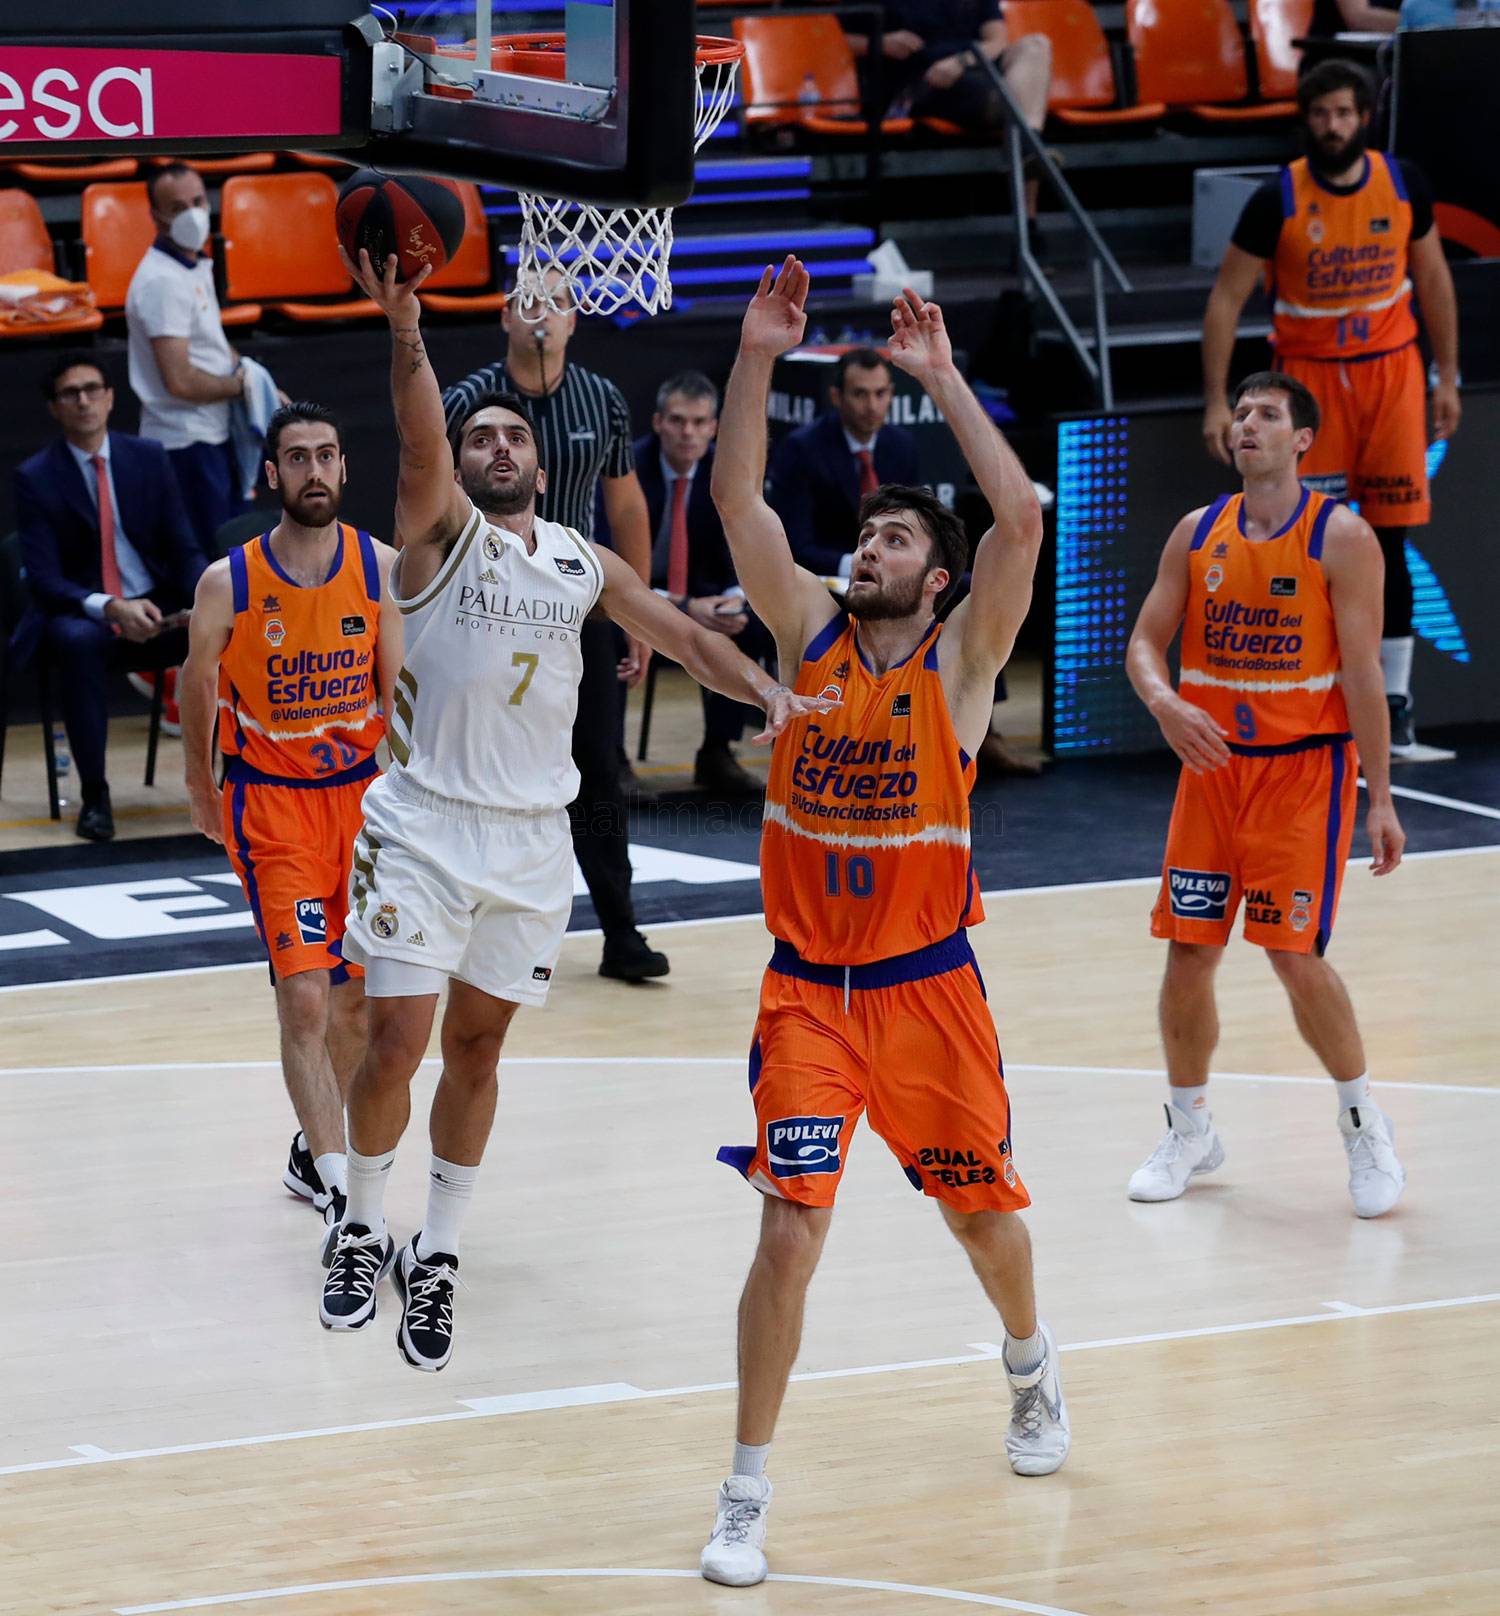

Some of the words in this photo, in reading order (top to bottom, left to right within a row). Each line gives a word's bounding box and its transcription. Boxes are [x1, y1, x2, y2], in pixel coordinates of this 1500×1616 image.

[1336, 317, 1370, 347] 14
[884, 394, 945, 425] ILA
[1204, 598, 1279, 627] Cultura
[1280, 614, 1303, 627] del
[456, 617, 516, 636] HOTEL
[534, 630, 579, 642] GRO
[1204, 624, 1303, 654] Esfuerzo
[267, 649, 354, 678] Cultura
[267, 672, 369, 705] Esfuerzo
[508, 652, 539, 706] 7
[1234, 702, 1257, 741] 9
[893, 743, 916, 762] del
[825, 851, 875, 899] 10
[912, 1147, 982, 1167] SUAL
